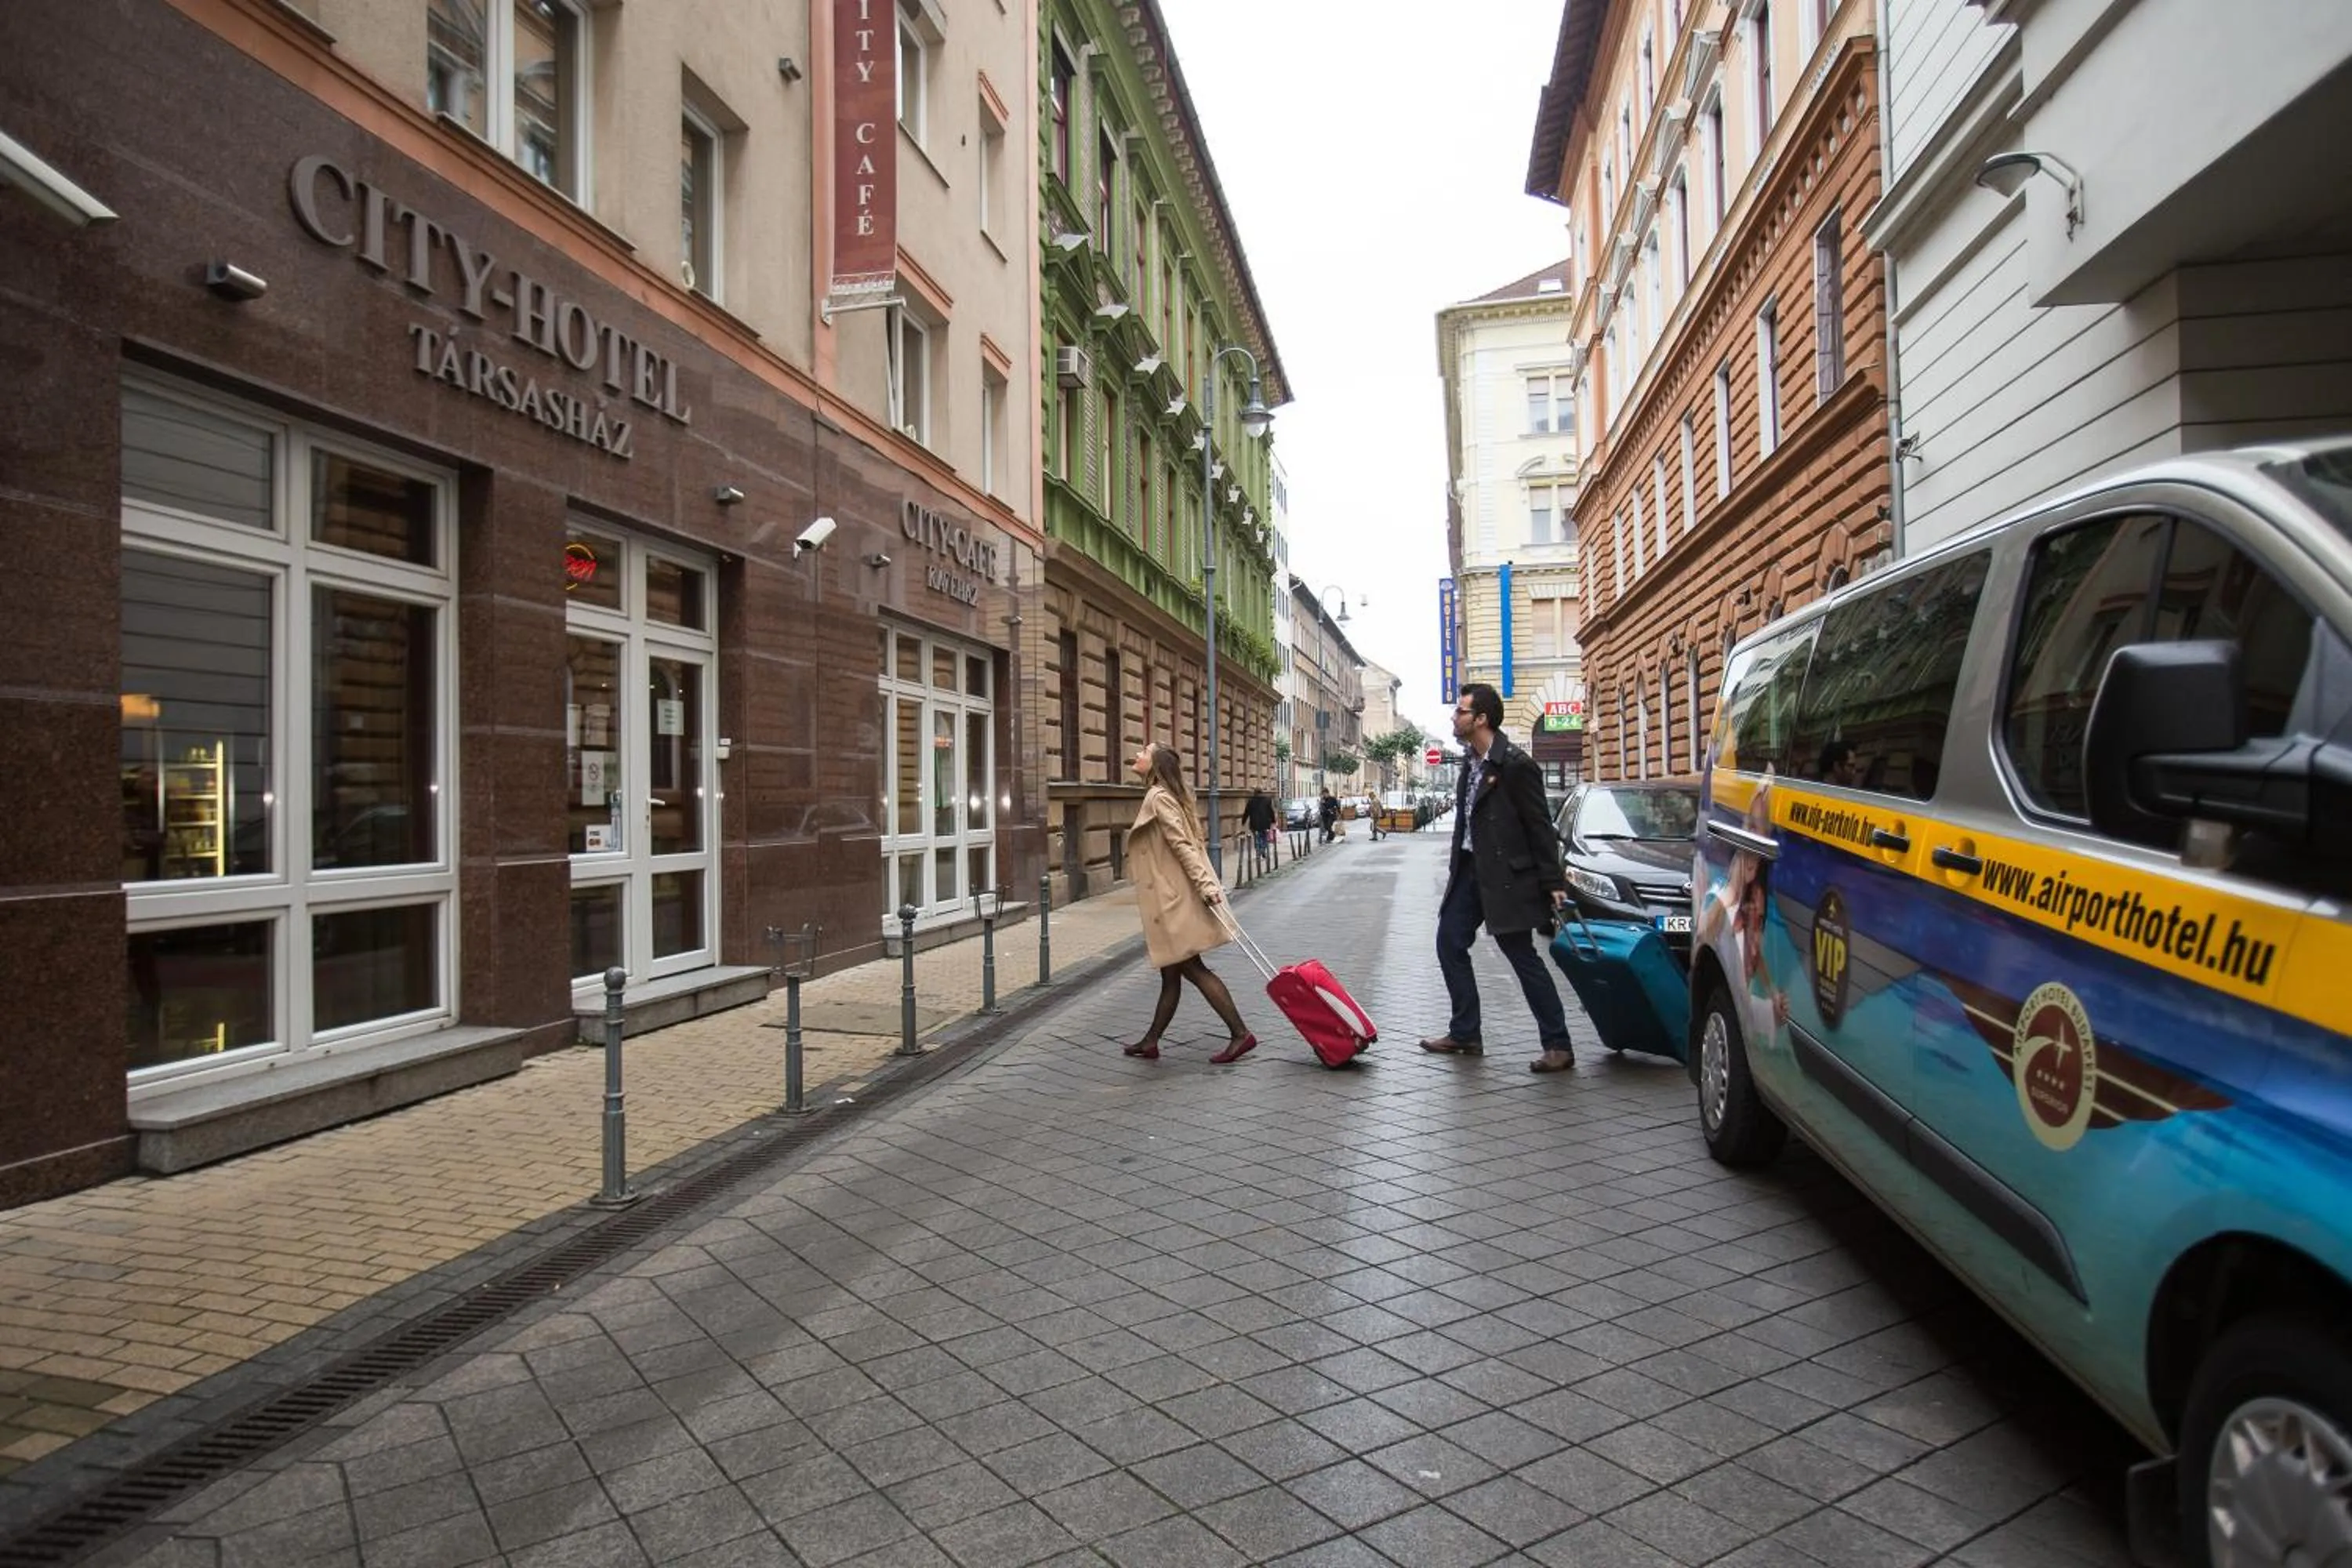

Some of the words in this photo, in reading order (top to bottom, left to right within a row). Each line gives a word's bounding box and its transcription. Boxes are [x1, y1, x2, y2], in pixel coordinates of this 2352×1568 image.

[855, 123, 876, 236] CAFÉ
[289, 155, 691, 425] CITY-HOTEL
[408, 322, 634, 459] TÁRSASHÁZ
[1548, 702, 1577, 715] ABC
[1548, 716, 1578, 728] 0-24
[1815, 927, 1846, 982] VIP
[1982, 858, 2278, 986] www.airporthotel.hu
[2013, 993, 2041, 1056] AIRPORT
[2041, 986, 2071, 1009] HOTEL
[2071, 1006, 2094, 1091] BUDAPEST
